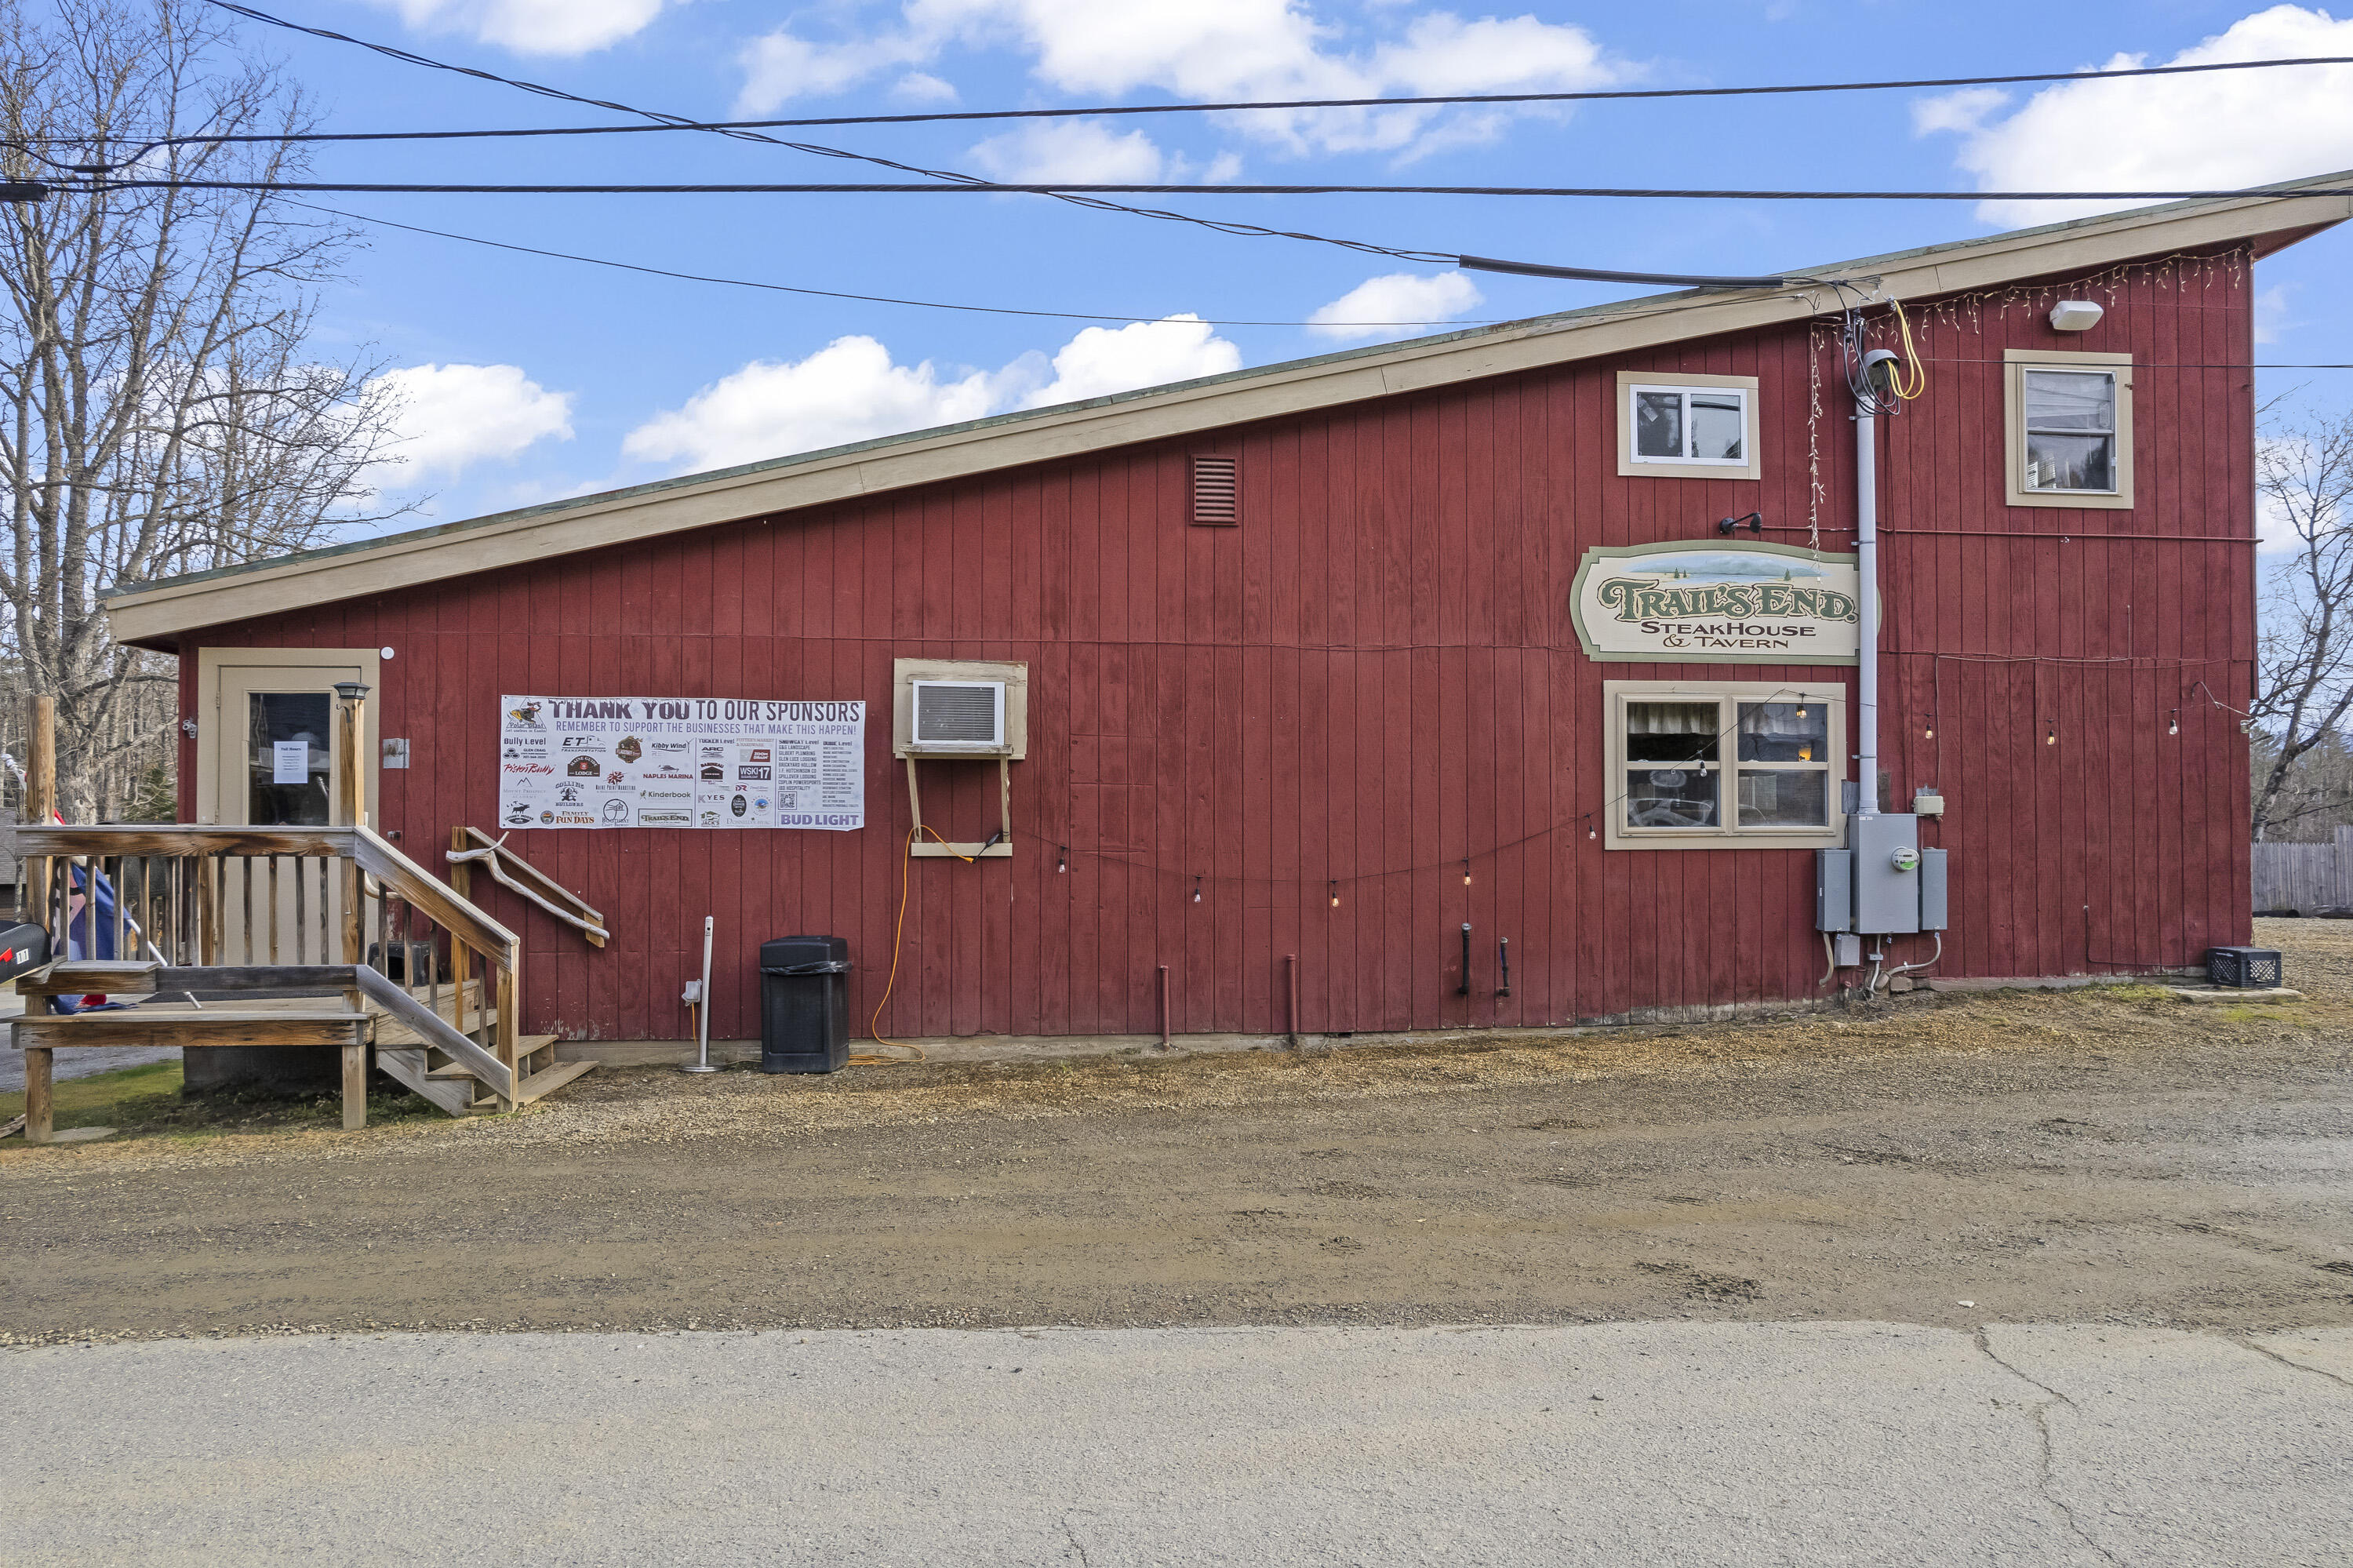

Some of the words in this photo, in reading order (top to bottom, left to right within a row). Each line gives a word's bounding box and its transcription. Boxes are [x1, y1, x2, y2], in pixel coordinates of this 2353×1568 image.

[1598, 577, 1755, 622] TRAIL'S
[1641, 621, 1816, 637] STEAKHOUSE
[1663, 634, 1691, 647] &
[1694, 636, 1788, 649] TAVERN
[548, 698, 632, 719] THANK
[641, 699, 689, 719] YOU
[696, 700, 717, 720] TO
[725, 700, 759, 721] OUR
[766, 701, 860, 722] SPONSORS
[556, 721, 606, 732] REMEMBER
[609, 722, 620, 732] TO
[624, 722, 664, 733] SUPPORT
[667, 722, 683, 733] THE
[686, 722, 740, 733] BUSINESSES
[744, 723, 766, 734] THAT
[769, 724, 793, 734] MAKE
[796, 725, 816, 735] THIS
[819, 725, 856, 735] HAPPEN!
[504, 737, 523, 746] Bully
[563, 737, 585, 746] ET
[570, 756, 584, 766] MAINE
[584, 756, 598, 767] GUIDE
[758, 767, 770, 779] 17
[780, 814, 813, 825] BUD
[815, 814, 860, 826] LIGHT
